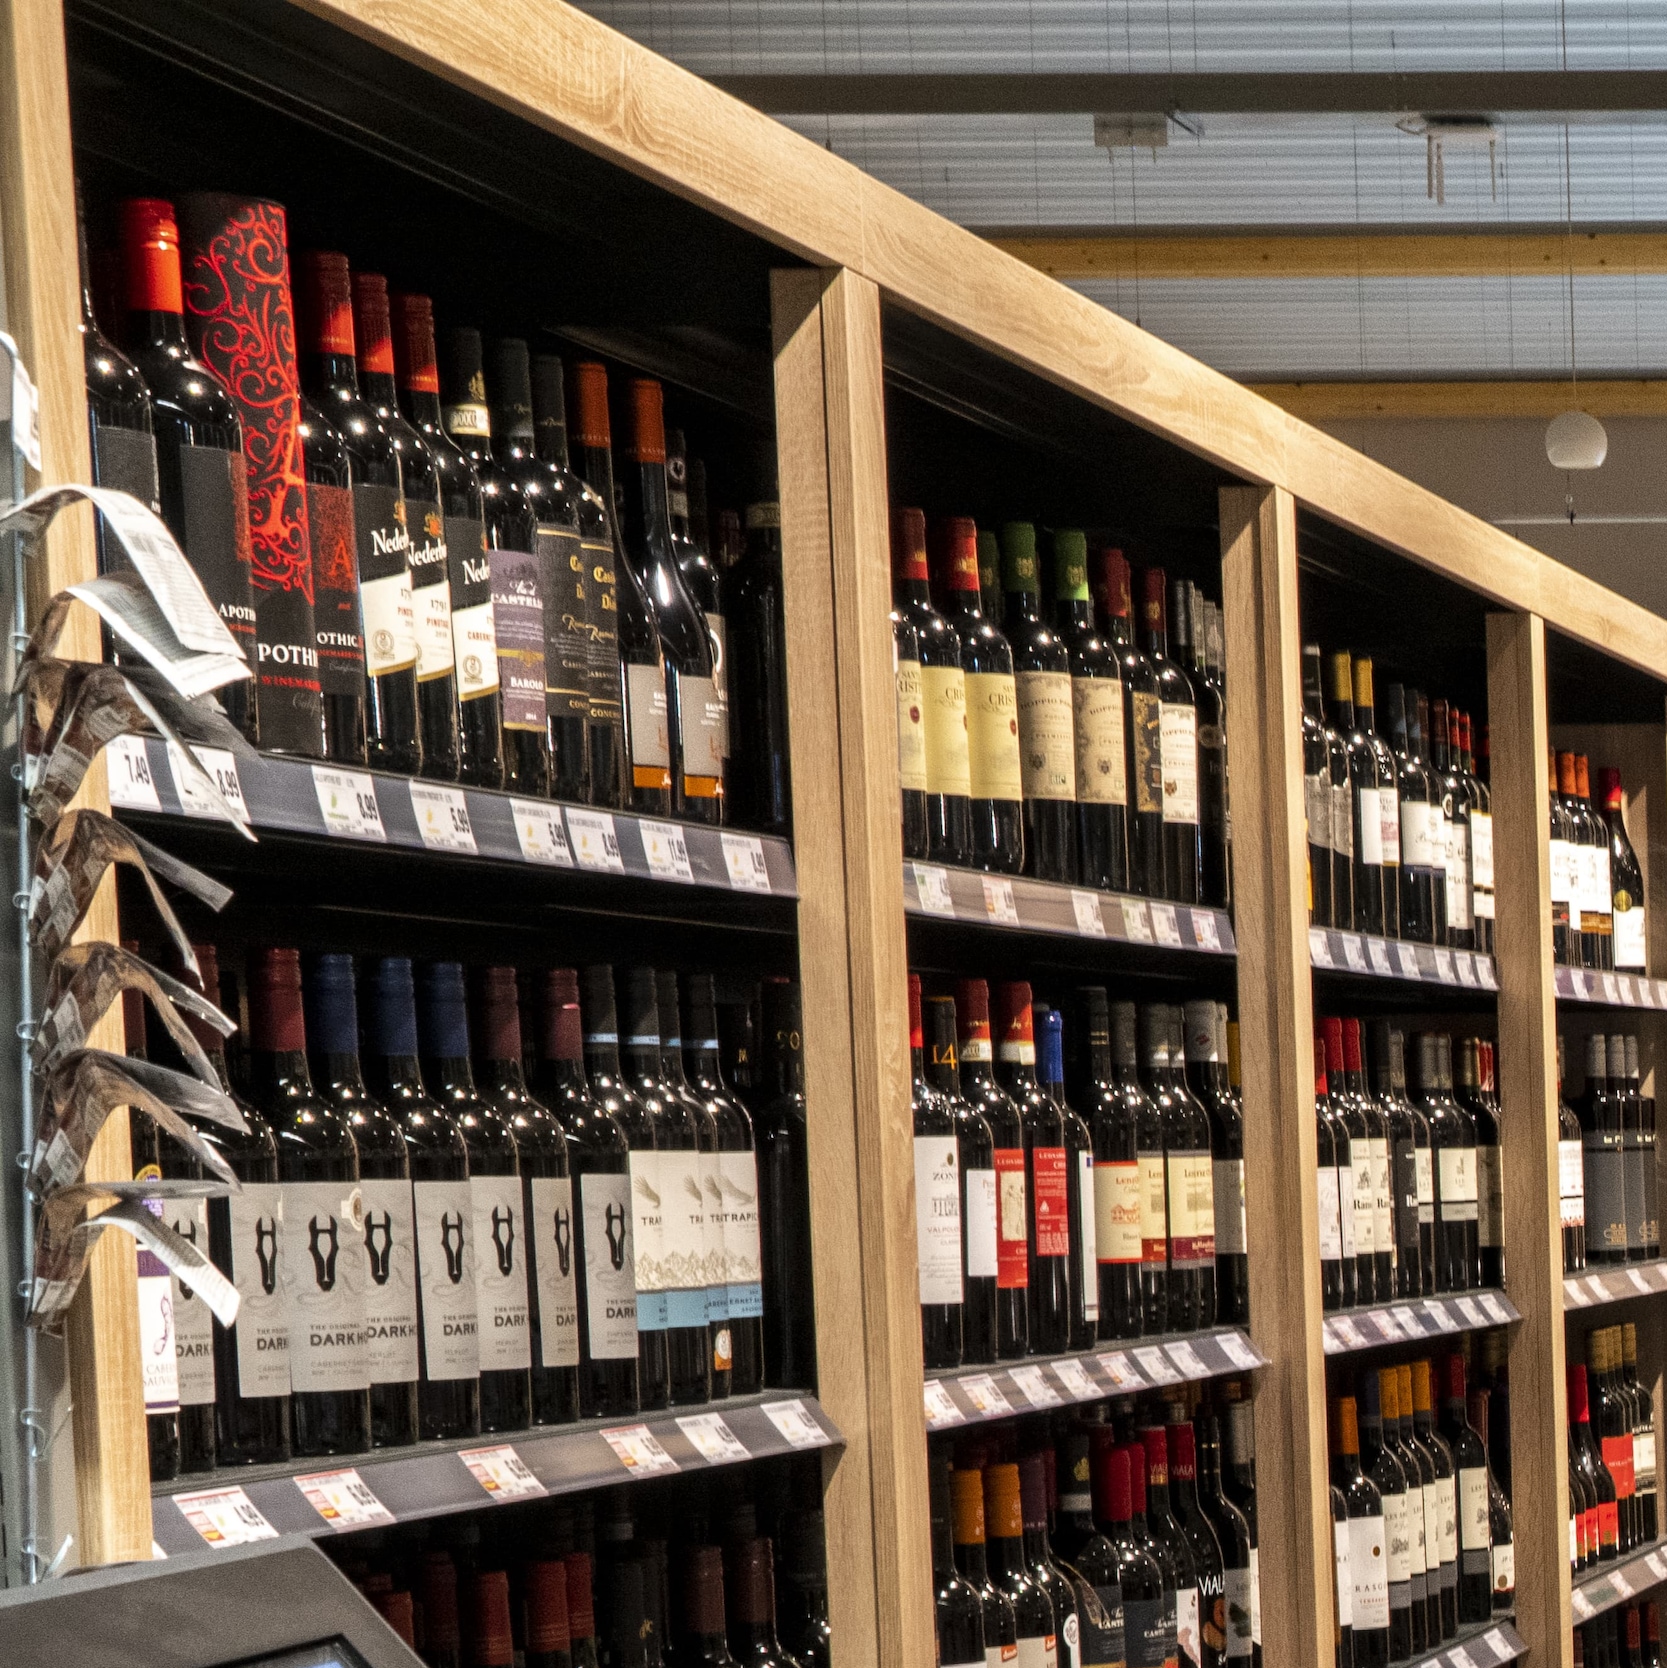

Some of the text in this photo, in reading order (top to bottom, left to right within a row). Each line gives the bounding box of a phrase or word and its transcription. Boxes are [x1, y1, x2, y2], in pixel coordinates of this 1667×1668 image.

[124, 754, 150, 785] 7.49
[217, 769, 239, 799] 8.99
[356, 794, 377, 820] 8.99
[450, 807, 470, 834] 5.99
